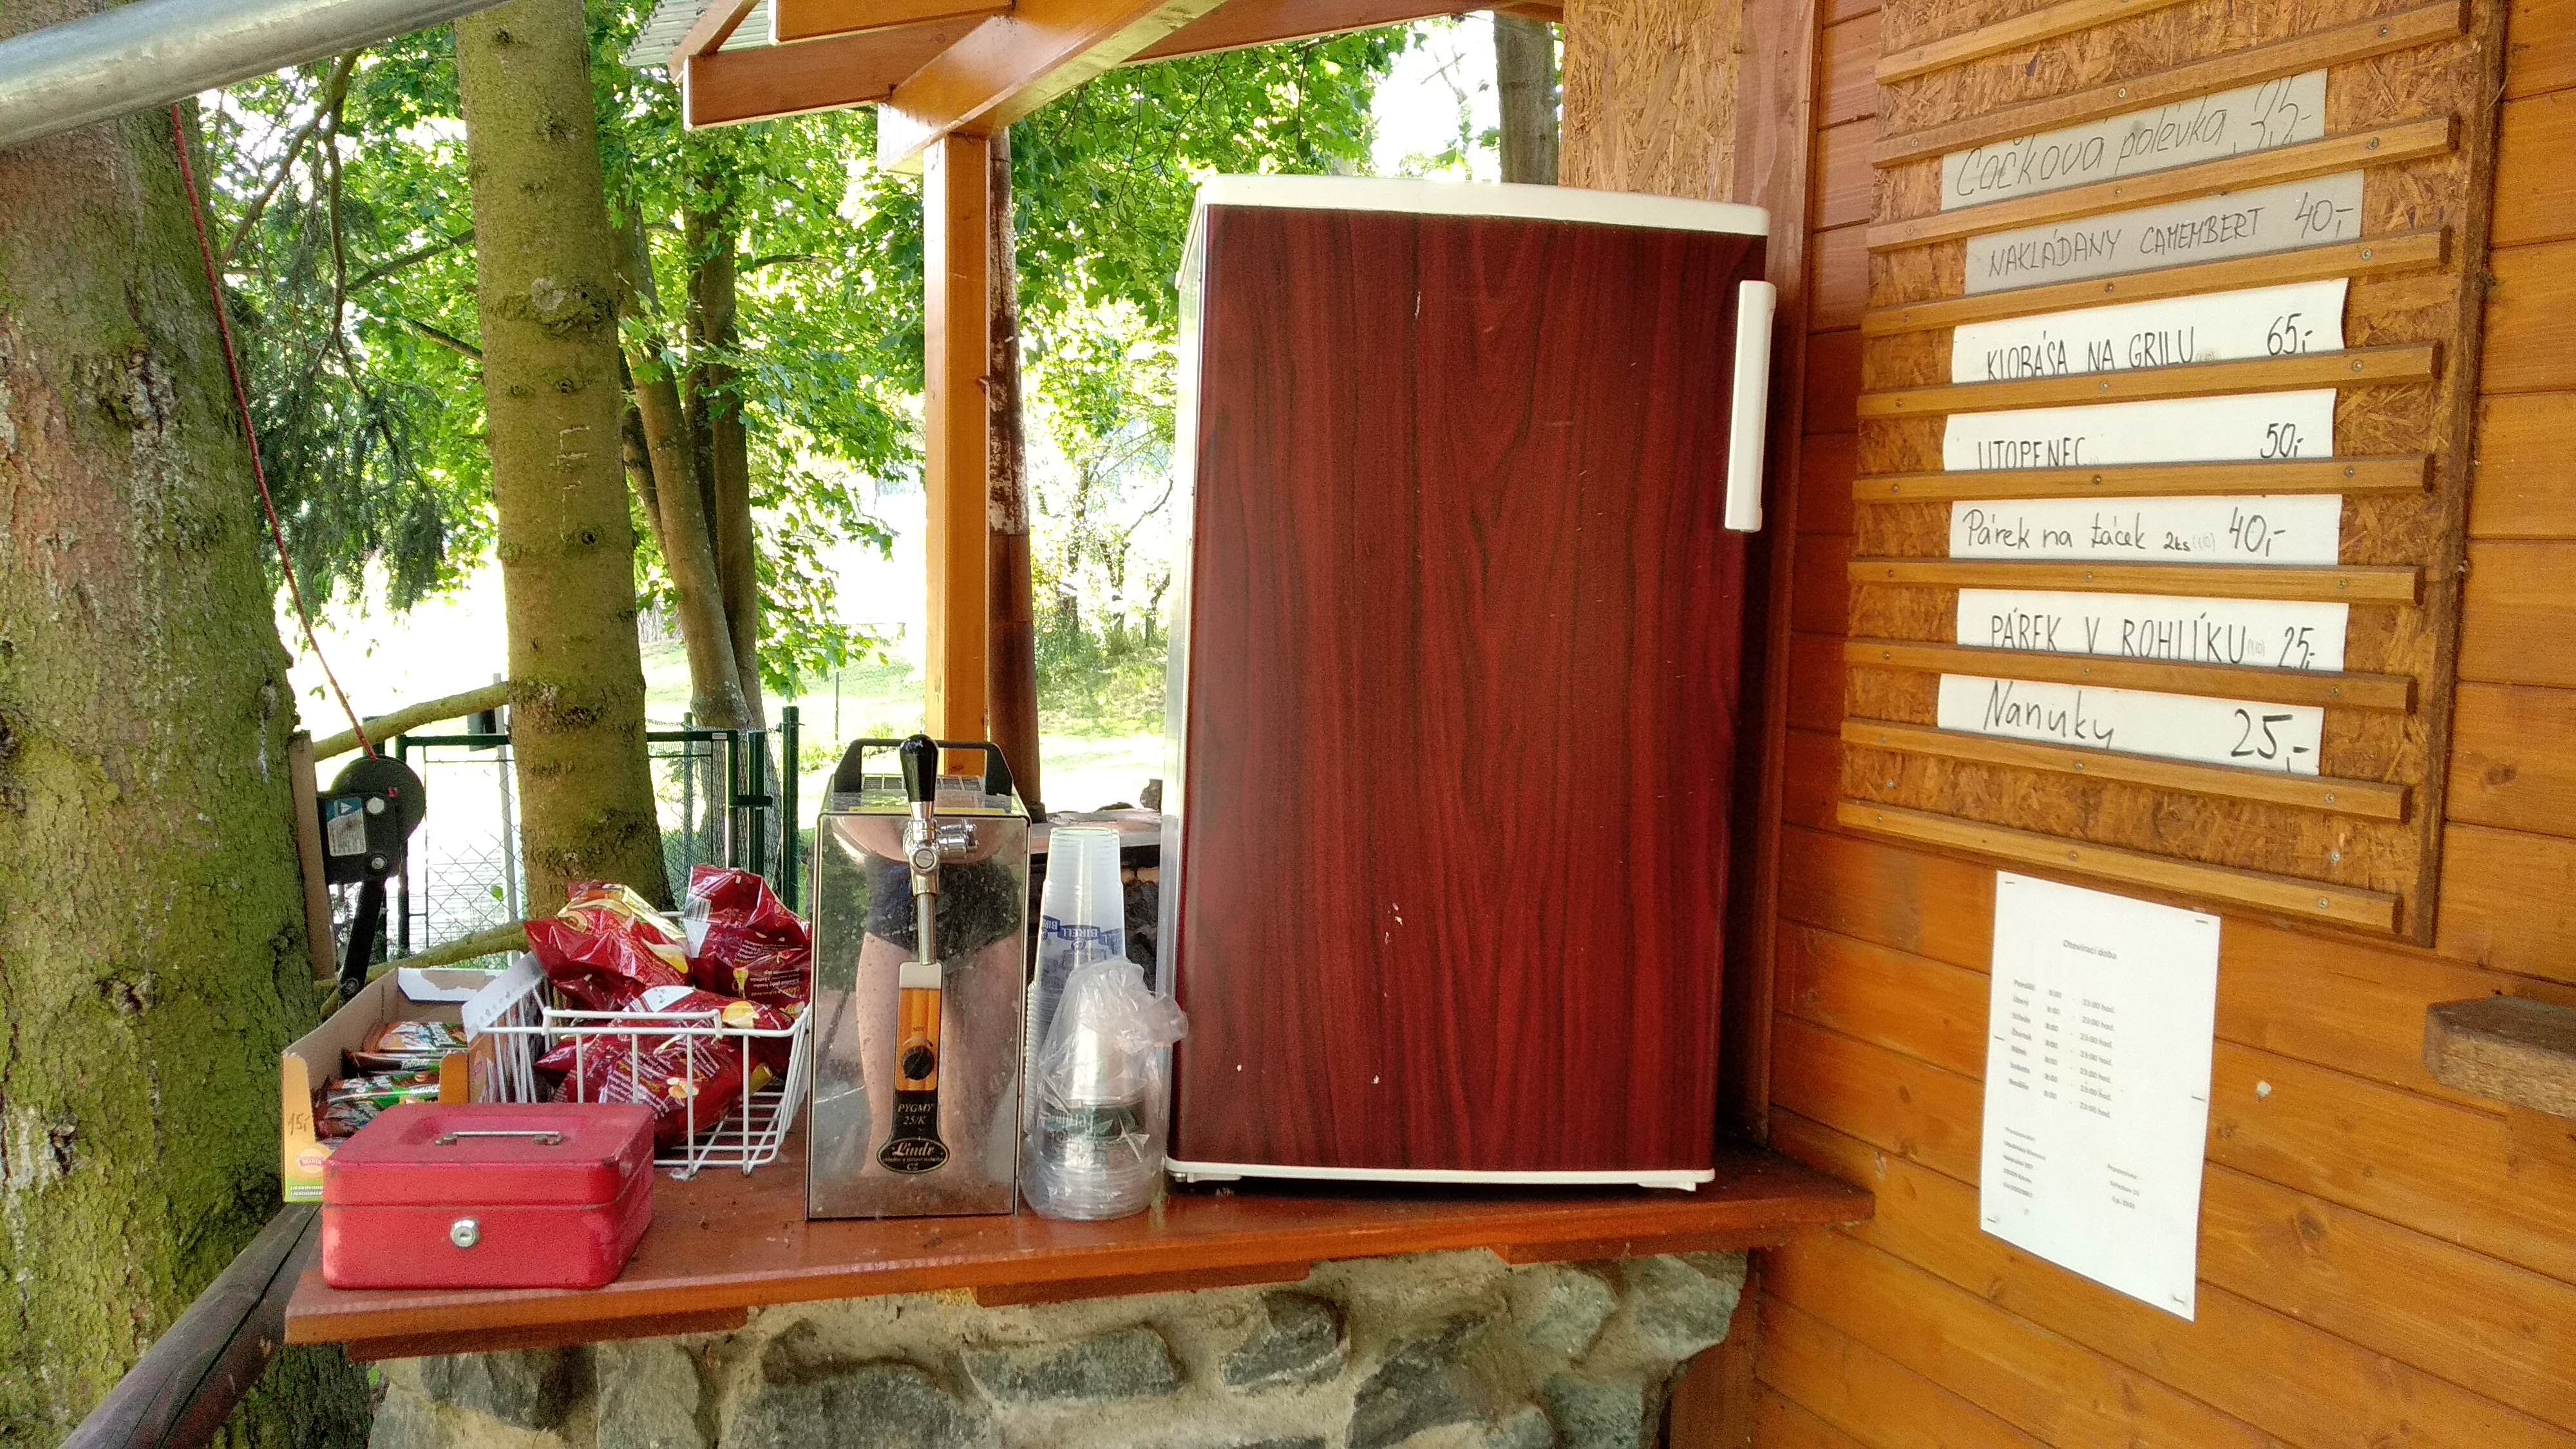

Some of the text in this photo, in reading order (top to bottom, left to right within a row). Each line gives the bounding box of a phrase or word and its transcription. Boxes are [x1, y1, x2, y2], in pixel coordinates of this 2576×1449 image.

[2139, 206, 2265, 256] CAMEMBERT
[2295, 191, 2354, 238] 40,-
[2088, 338, 2115, 372] NA
[2129, 326, 2193, 368] GRILU
[1963, 509, 2030, 549] Párek
[2043, 527, 2072, 549] na
[2091, 512, 2146, 549] tácek
[2229, 506, 2286, 557] 40,-
[1991, 607, 2061, 652] PÁREK
[2085, 616, 2101, 653] V
[2121, 611, 2246, 664] ROHLÍKU
[1982, 679, 2310, 773] Nanuky 25,-
[1061, 927, 1098, 938] BIRELL
[898, 1103, 933, 1113] PYGMY
